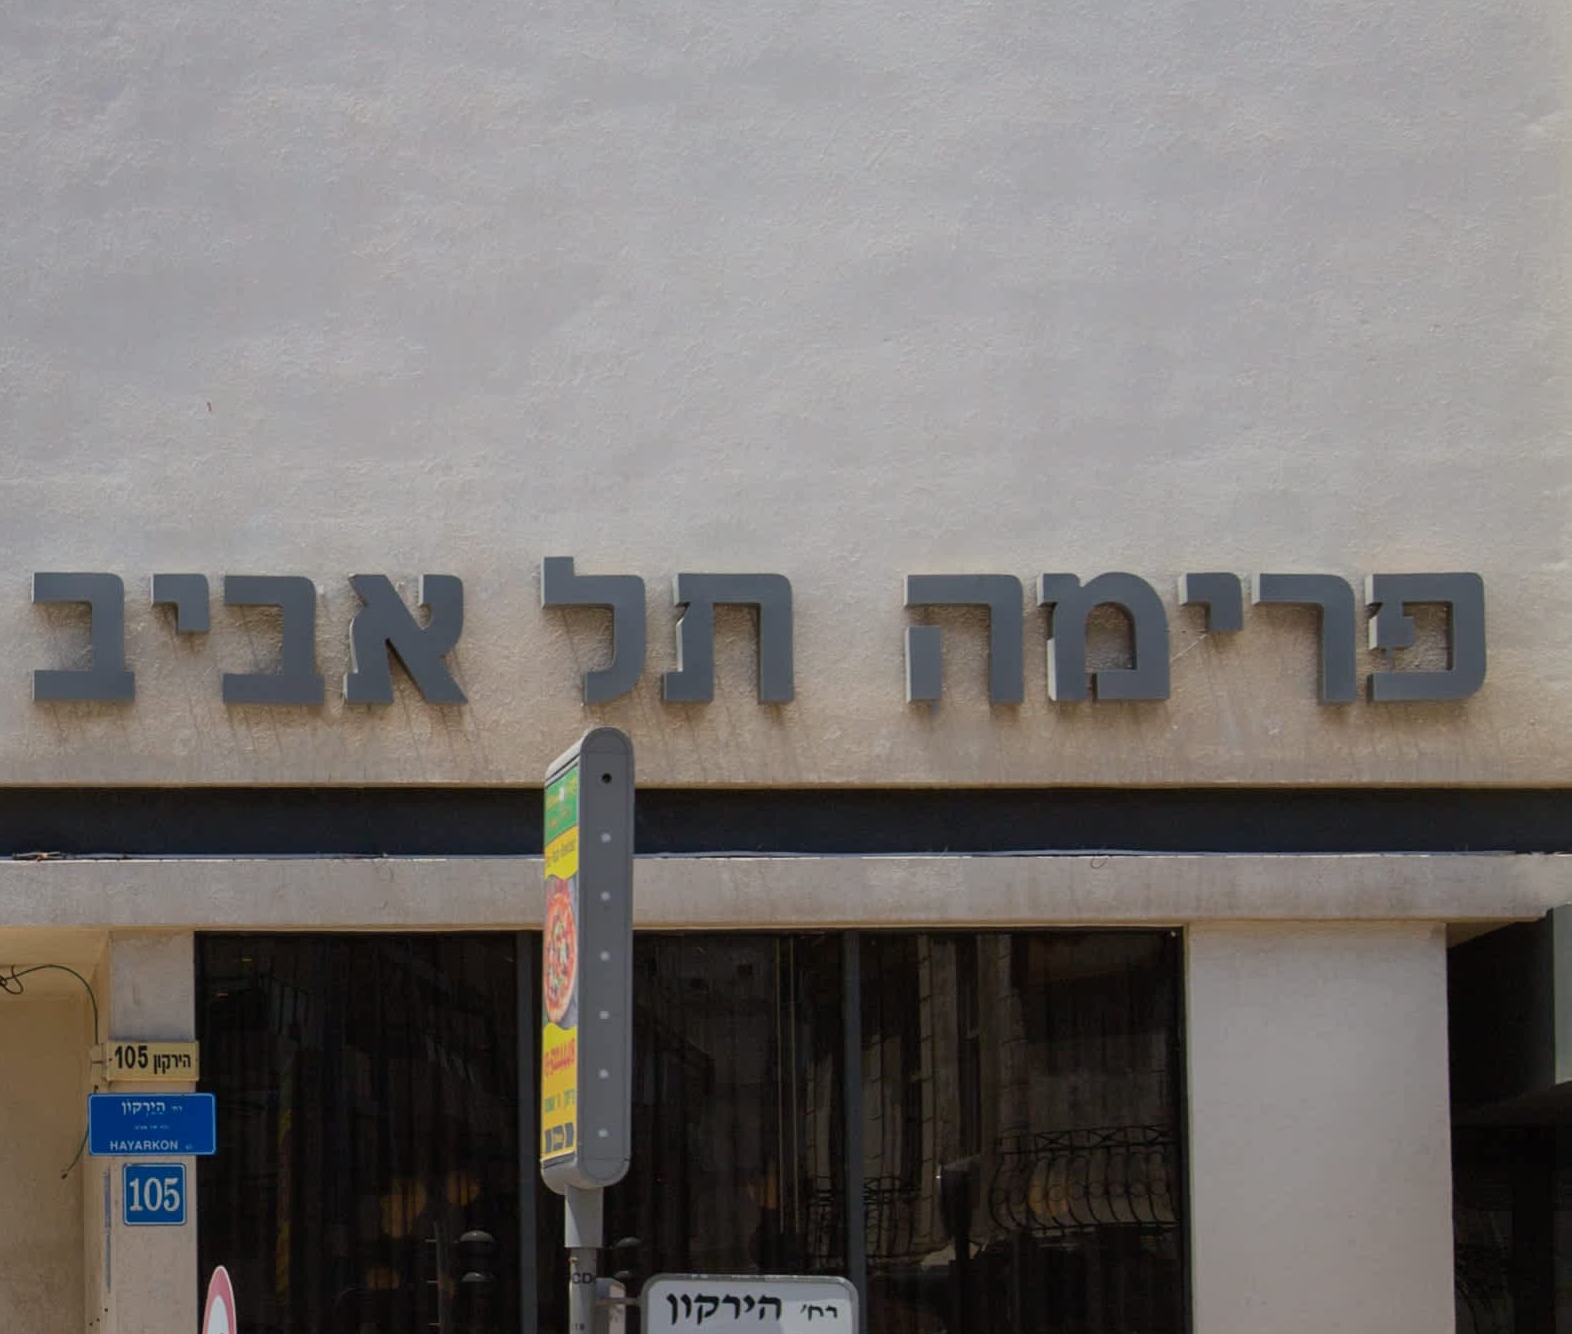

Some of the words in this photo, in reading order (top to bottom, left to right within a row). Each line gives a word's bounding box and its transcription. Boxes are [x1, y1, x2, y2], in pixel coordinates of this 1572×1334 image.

[31, 571, 468, 705] אביב
[539, 556, 795, 706] תל
[904, 571, 1487, 704] פרימה
[115, 1046, 148, 1069] 105
[153, 1053, 192, 1075] הירקון
[109, 1139, 179, 1151] HAYARKON
[129, 1177, 181, 1213] 105
[666, 1292, 783, 1326] הירקון
[800, 1303, 839, 1321] רח'
